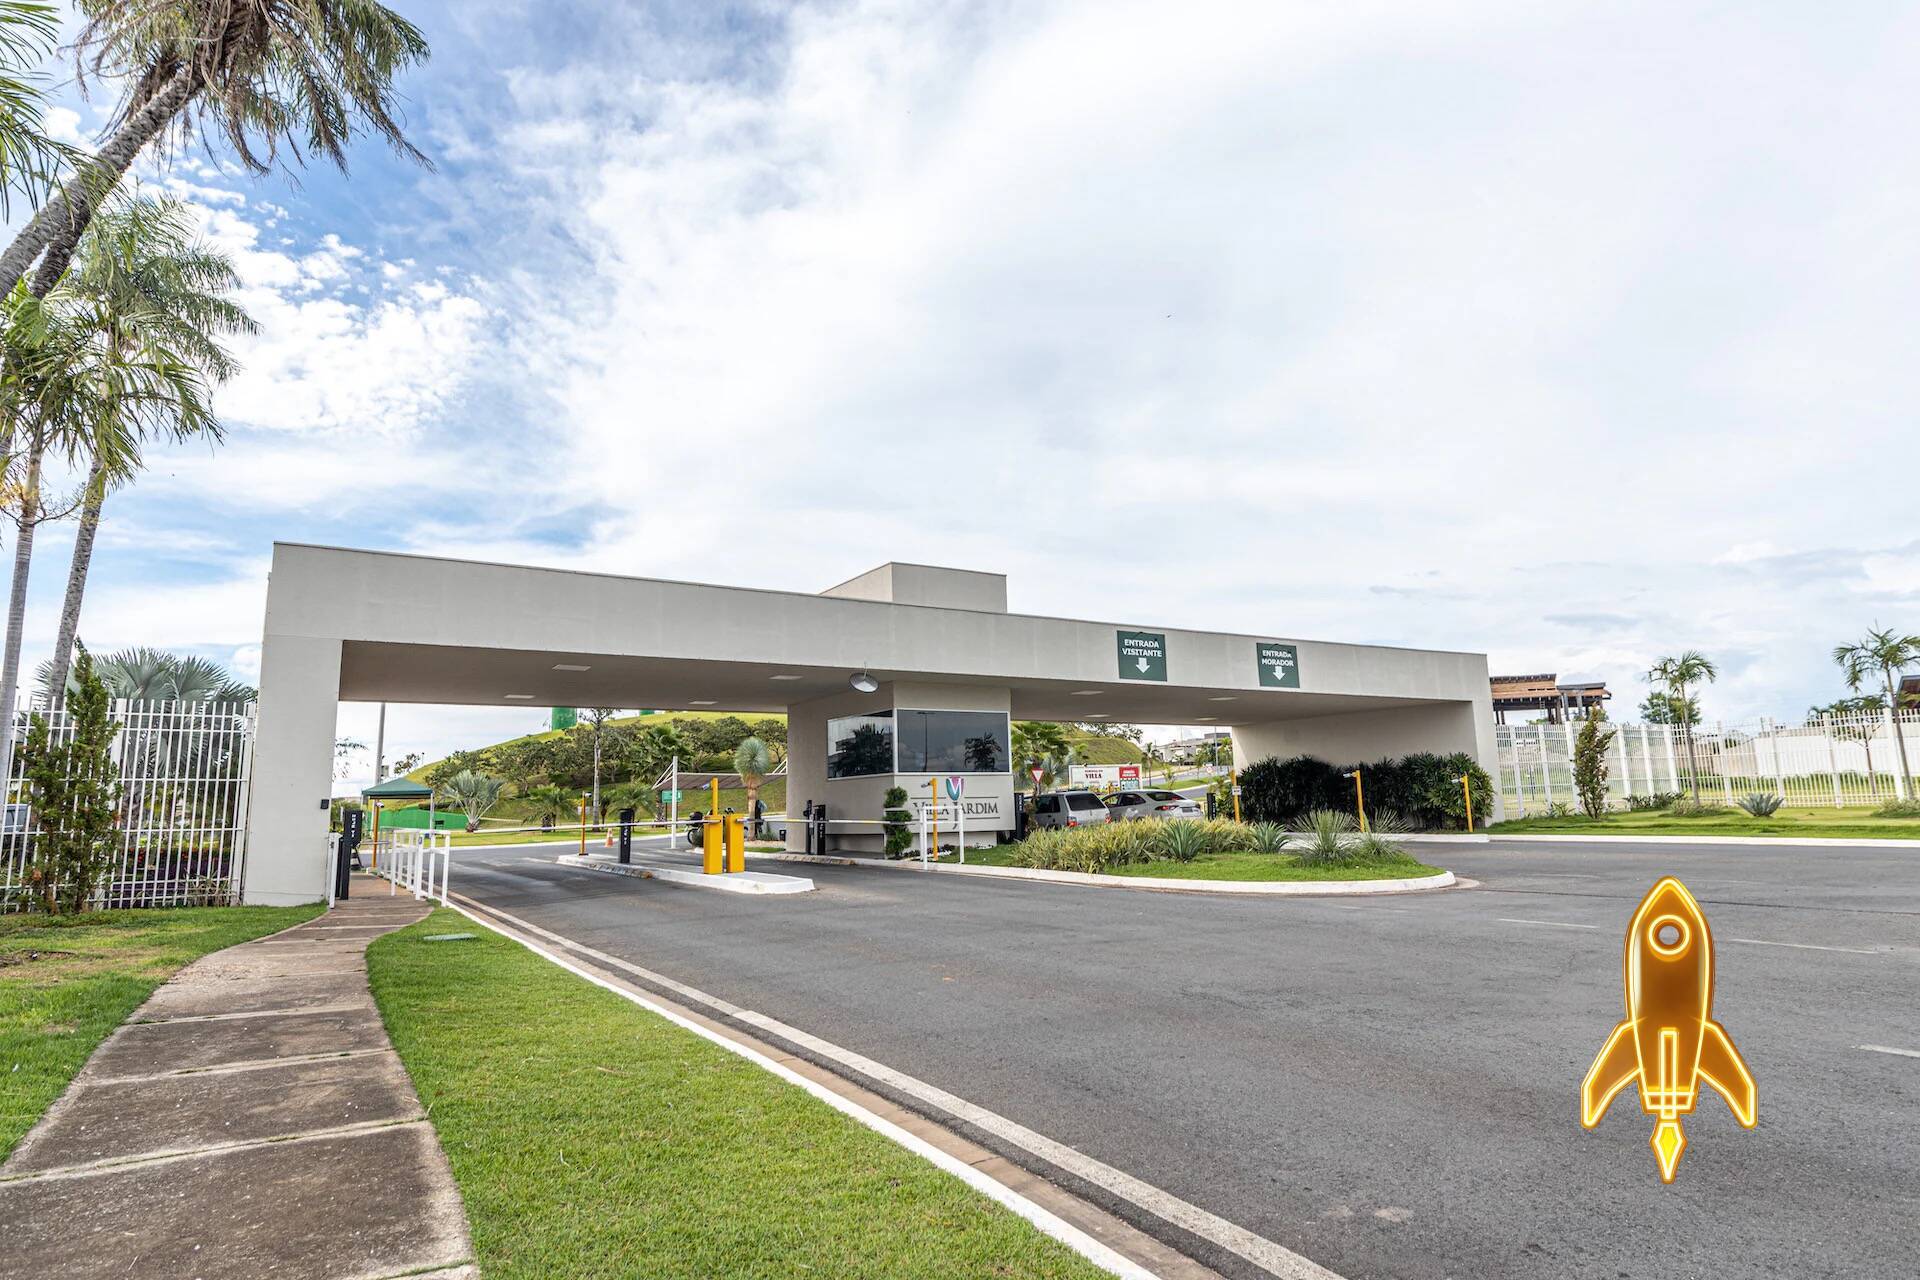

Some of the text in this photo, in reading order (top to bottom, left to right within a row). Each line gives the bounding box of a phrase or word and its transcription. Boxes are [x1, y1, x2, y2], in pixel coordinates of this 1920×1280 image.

[1124, 638, 1160, 649] ENTRADA
[1121, 647, 1163, 658] VISITANTE
[1262, 649, 1292, 659] ENTRADA
[1261, 658, 1294, 667] MORADOR
